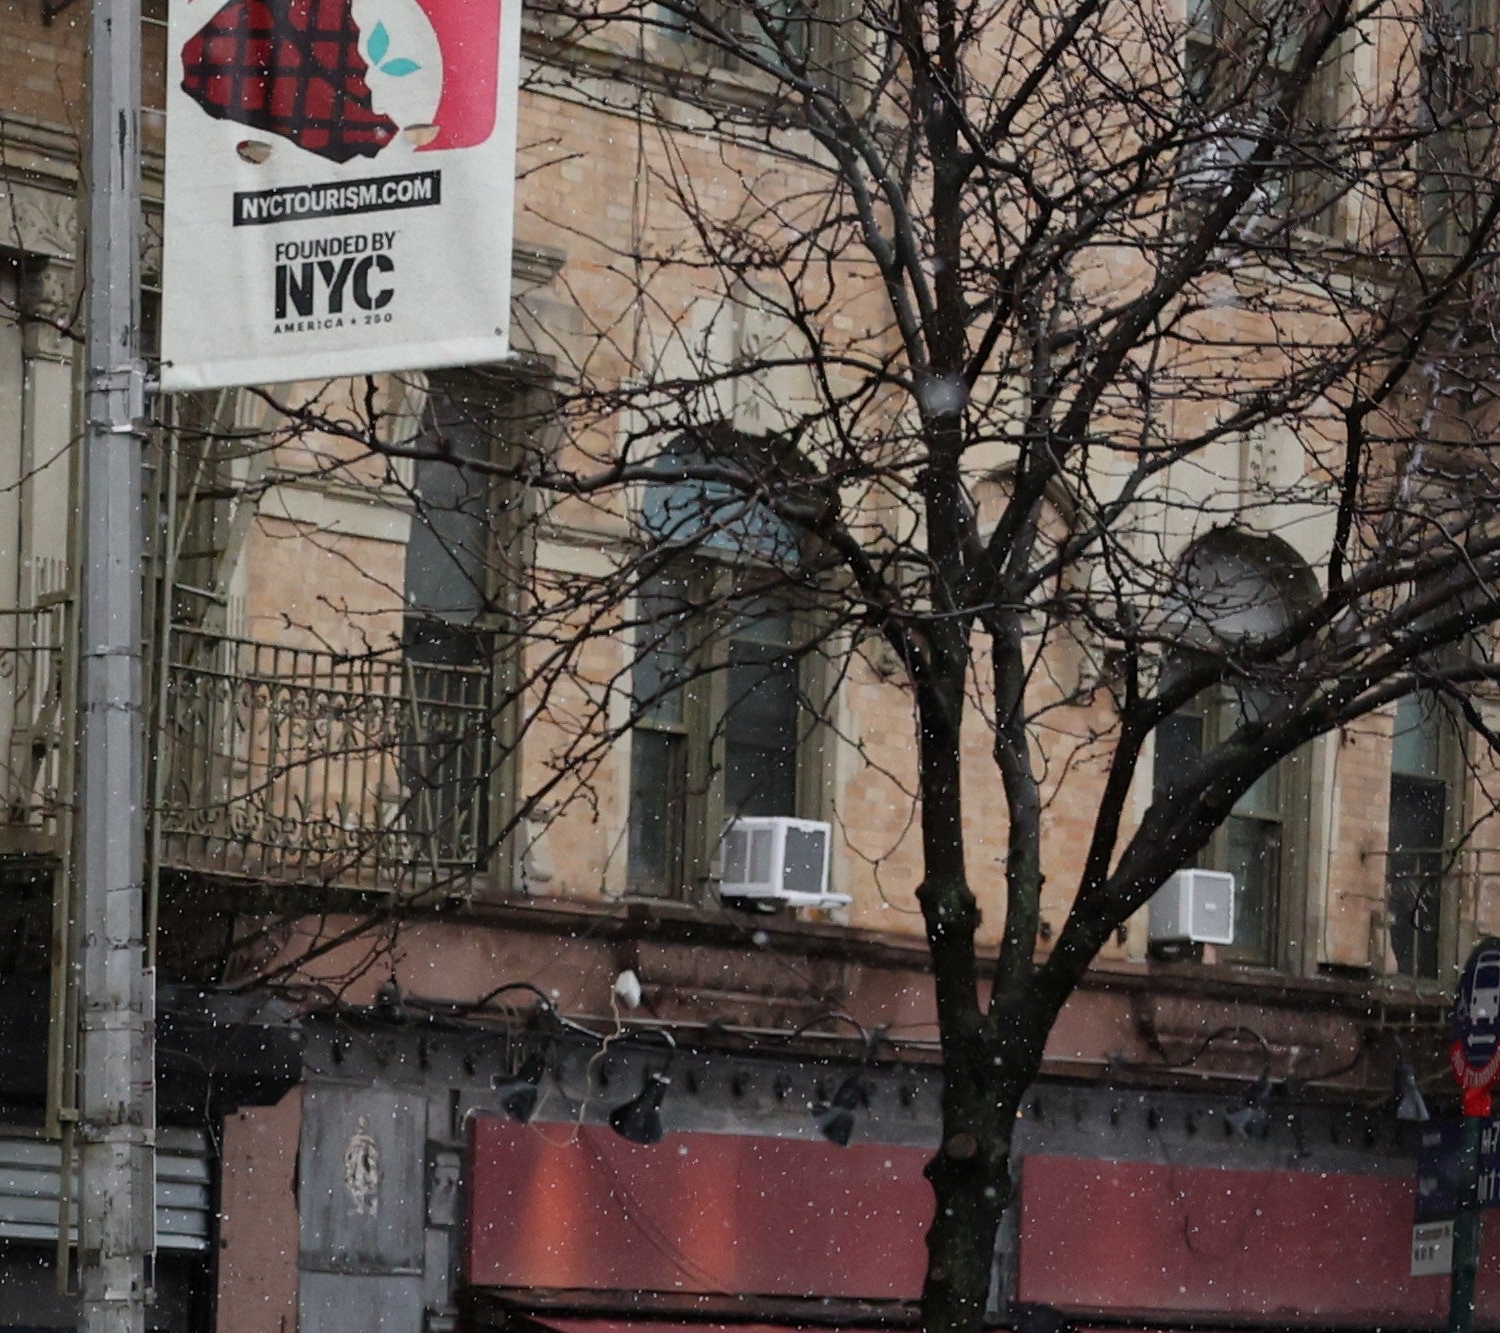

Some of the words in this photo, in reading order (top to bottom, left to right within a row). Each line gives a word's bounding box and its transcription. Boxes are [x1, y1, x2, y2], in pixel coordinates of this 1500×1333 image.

[241, 177, 433, 220] NYCTOURISM.COM
[274, 235, 368, 263] FOUNDED
[371, 231, 396, 252] BY
[274, 253, 395, 320] NYC
[273, 318, 344, 335] AMERICA
